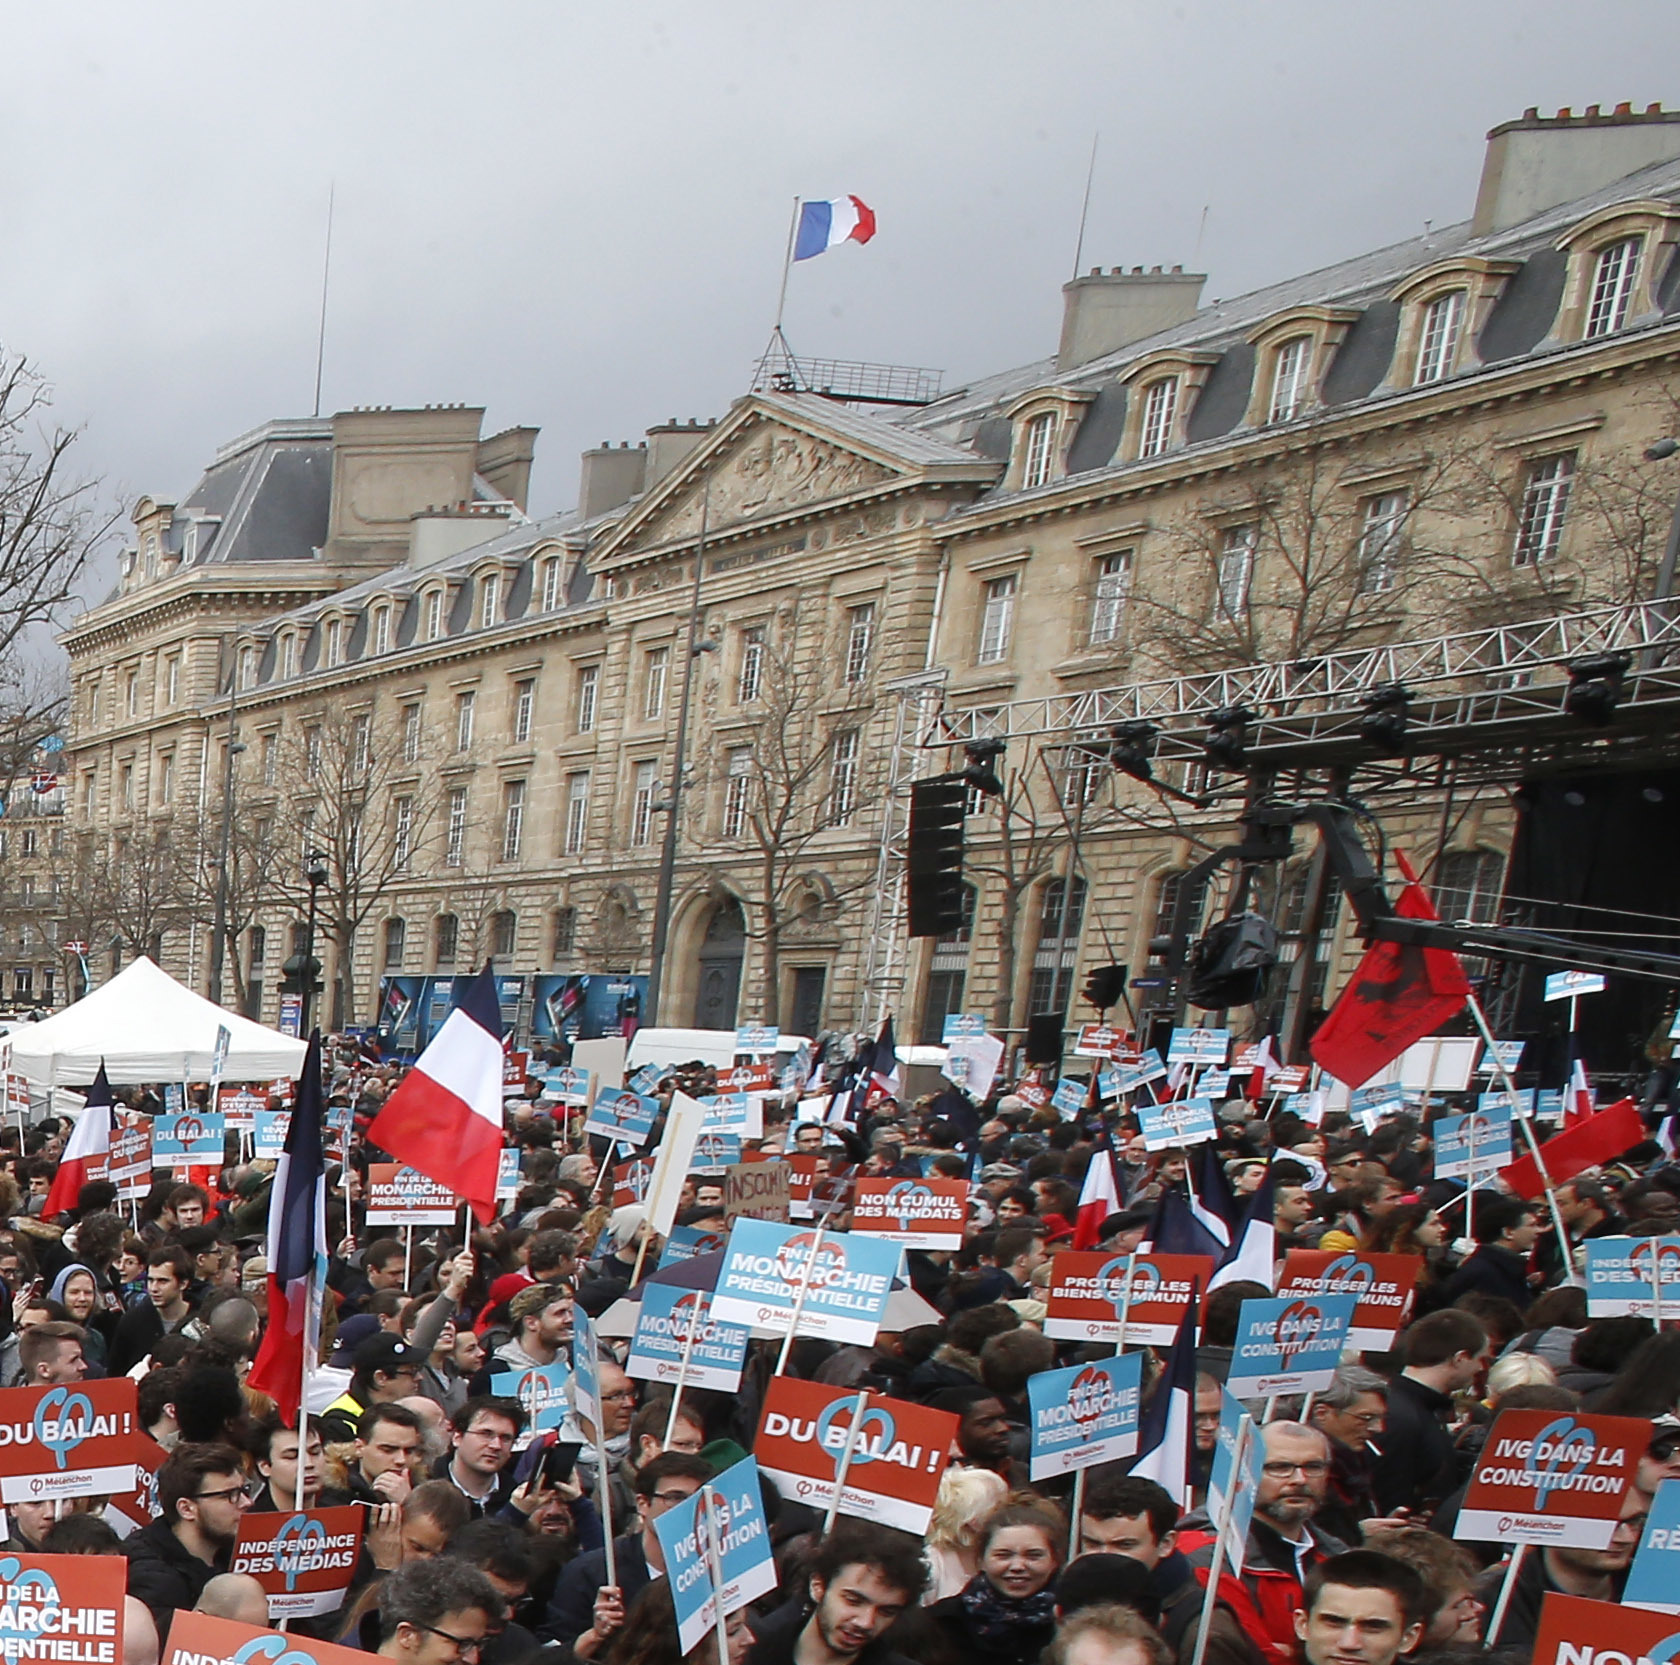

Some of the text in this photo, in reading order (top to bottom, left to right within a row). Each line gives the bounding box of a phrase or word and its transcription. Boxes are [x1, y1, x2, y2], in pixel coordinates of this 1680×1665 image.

[156, 1128, 215, 1141] DU BALAI
[370, 1183, 454, 1196] MONARCHIE
[370, 1193, 454, 1207] PRÉSIDENTIELLE
[860, 1194, 959, 1209] NON CUMUL
[854, 1205, 963, 1220] DES MANDATS
[775, 1246, 847, 1268] FIN LA
[729, 1252, 888, 1294] MONARCHIE
[1592, 1270, 1636, 1283] DES
[725, 1273, 881, 1313] PRÉSIDENTIELLE
[1051, 1287, 1104, 1299] BIENS
[1064, 1276, 1192, 1292] PROTÉGER LES
[1290, 1276, 1398, 1294] PROTÉGER LES
[640, 1315, 747, 1346] MONARCHIE
[1249, 1316, 1342, 1337] IVG DANS LA
[637, 1335, 742, 1363] PRÉSIDENTIELLE
[1240, 1337, 1340, 1358] CONSTITUTION
[1036, 1385, 1138, 1425] MONARCHIE
[41, 1412, 117, 1440] BALAI
[1037, 1408, 1137, 1447] PRÉSIDENTIELLE
[764, 1412, 922, 1469] DU BALAI
[1495, 1439, 1625, 1467] IVG DANS LA
[44, 1472, 93, 1488] Mélenchon
[1478, 1466, 1624, 1495] CONSTITUTION
[673, 1493, 753, 1563] IVG LA
[1514, 1517, 1565, 1531] Mélenchon
[238, 1533, 356, 1555] INDÉPENDANCE
[233, 1550, 354, 1573] DES MÉDIAS
[6, 1584, 32, 1602] DE
[34, 1584, 61, 1603] LA
